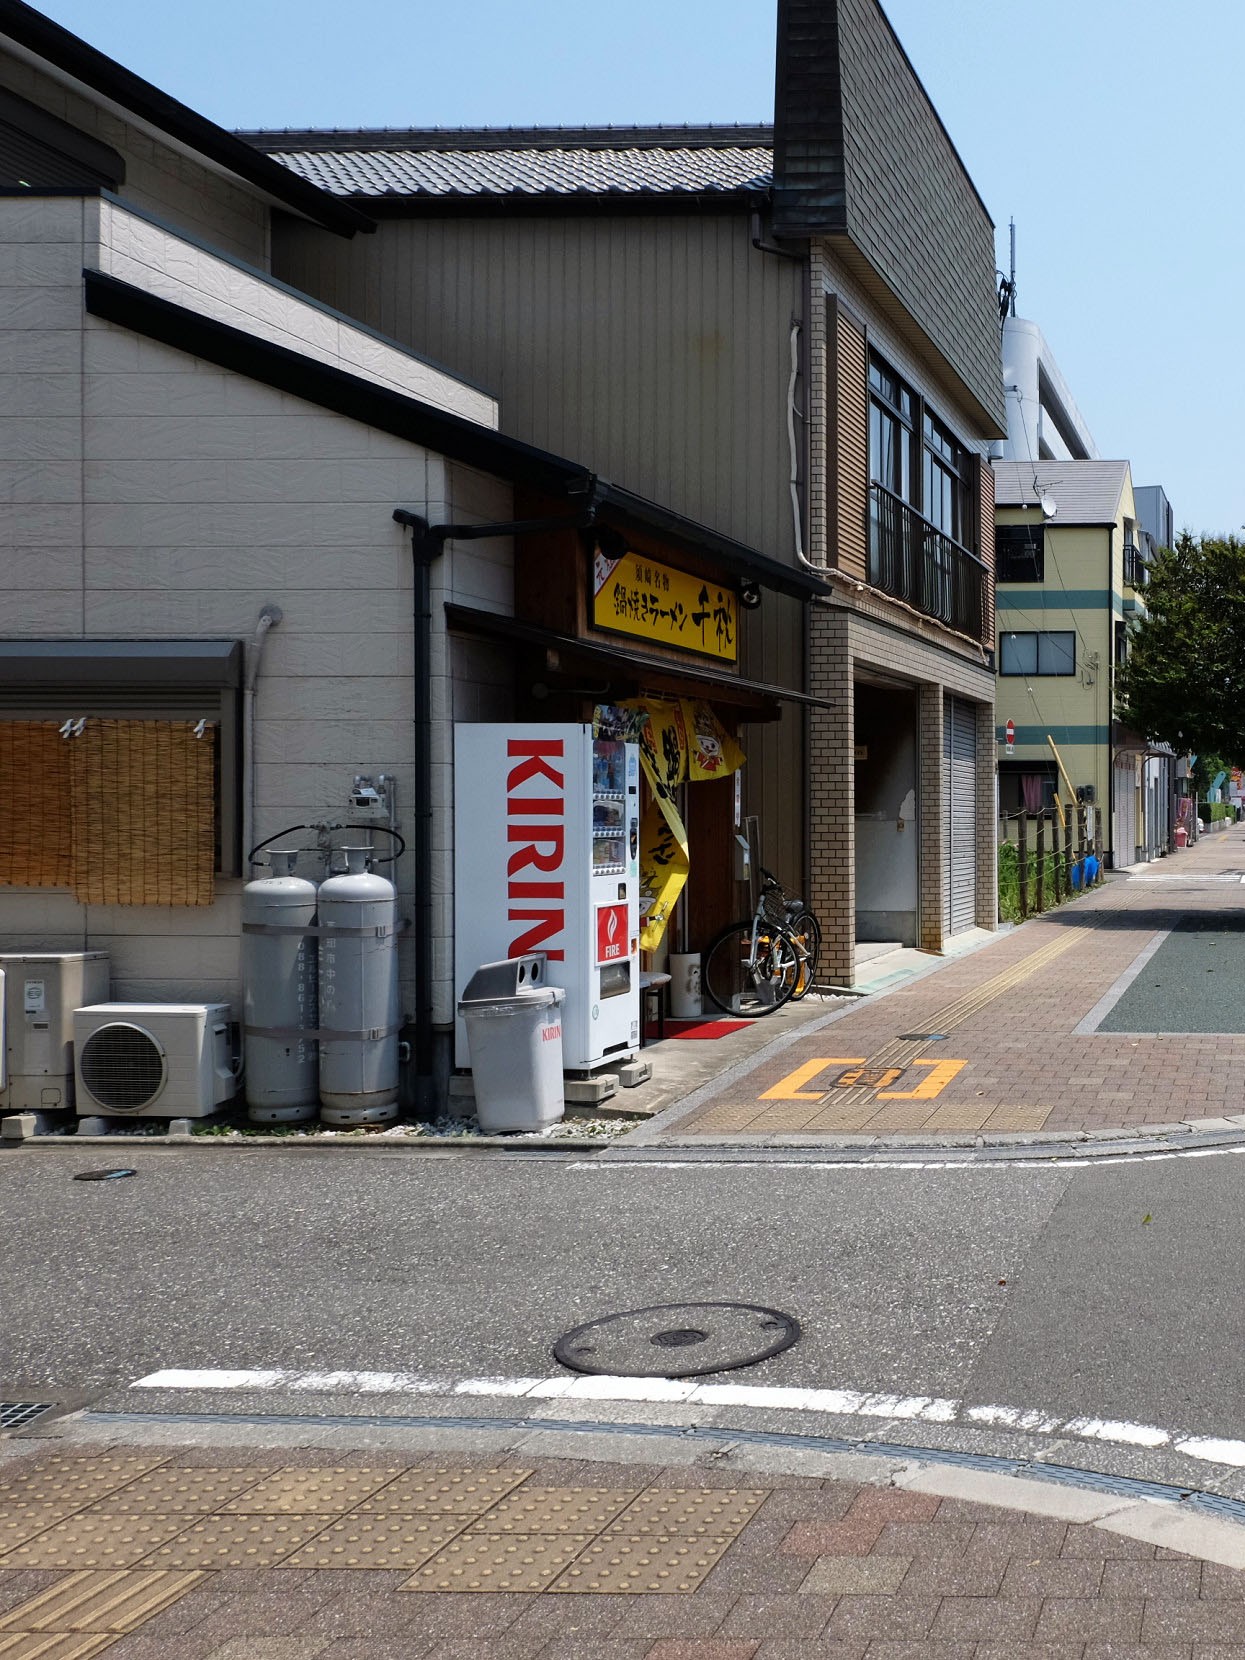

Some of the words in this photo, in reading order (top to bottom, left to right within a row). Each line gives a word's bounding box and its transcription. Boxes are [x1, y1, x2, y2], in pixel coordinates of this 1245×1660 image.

[613, 582, 688, 632] 鍋焼きラーメン
[691, 583, 735, 653] 千秋
[506, 738, 565, 962] KIRIN
[604, 943, 621, 958] FIRE
[542, 1024, 562, 1042] KIRIN
